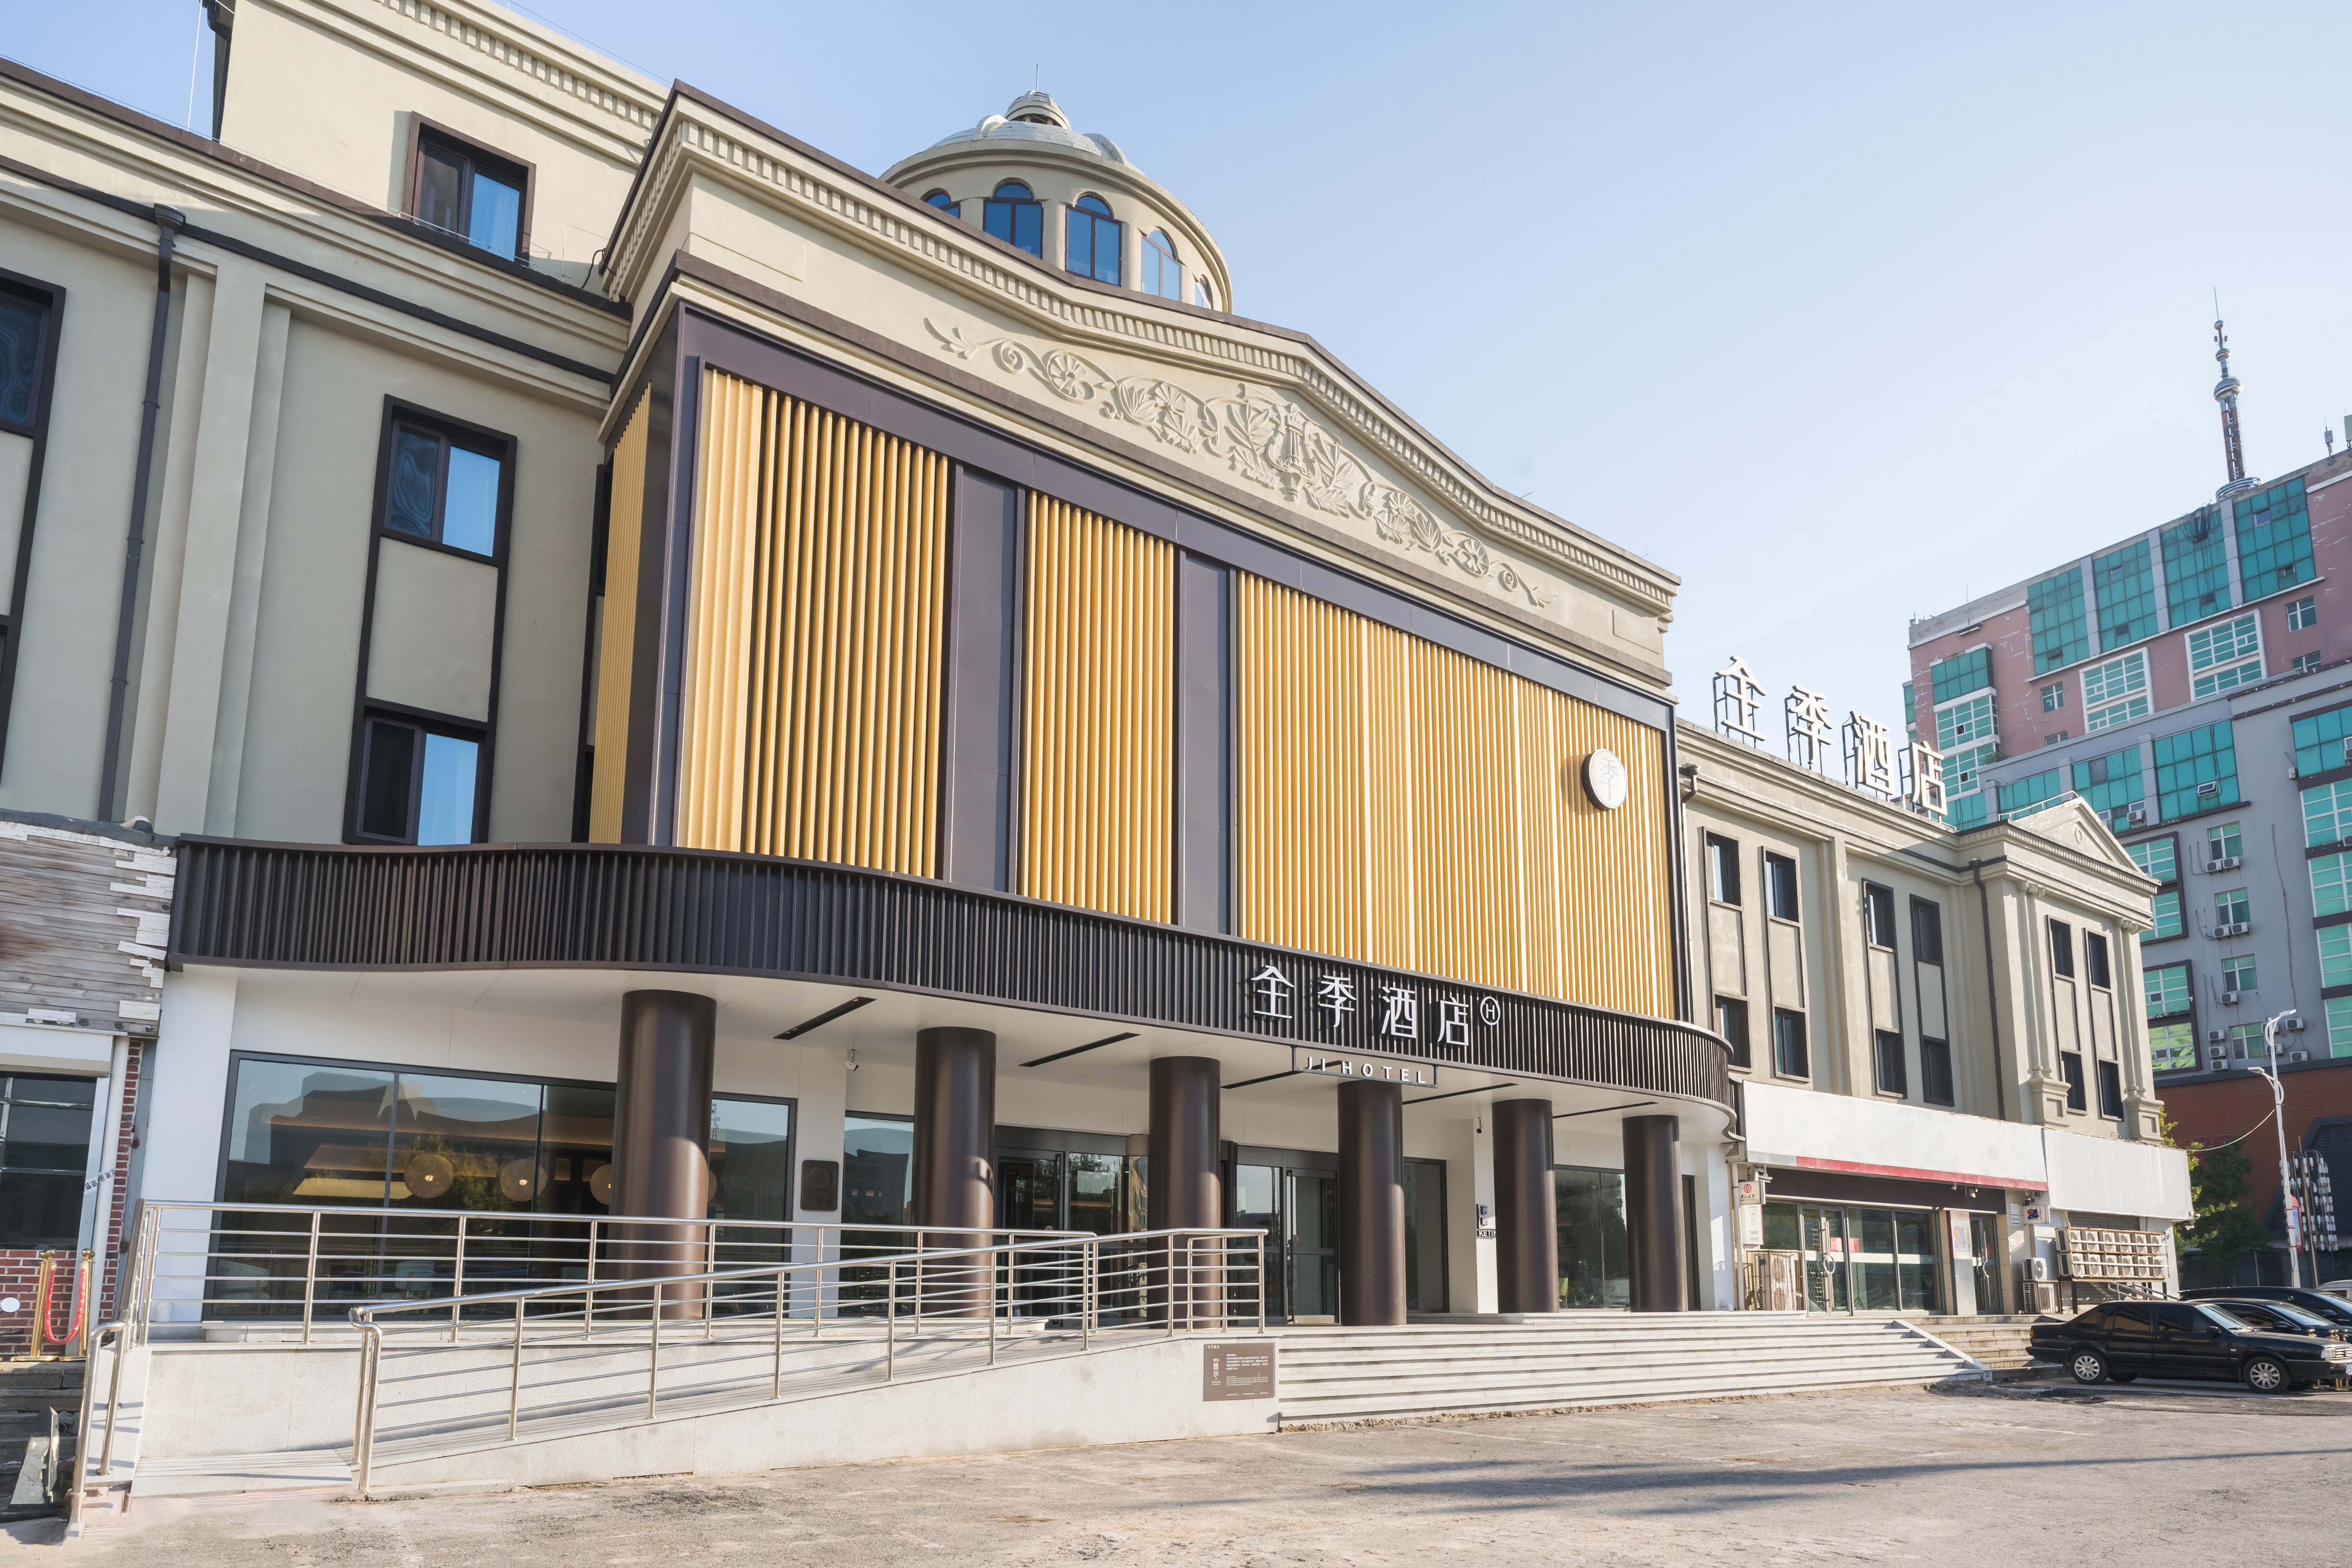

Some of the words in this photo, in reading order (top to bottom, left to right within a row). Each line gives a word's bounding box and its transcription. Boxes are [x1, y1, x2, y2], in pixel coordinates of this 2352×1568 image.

[1715, 655, 1947, 816] 全季酒店
[1597, 757, 1619, 801] 季
[1250, 965, 1469, 1047] 全季酒店
[1308, 1056, 1325, 1072] JI
[1341, 1060, 1426, 1083] HOTEL
[1213, 1362, 1219, 1377] 提示
